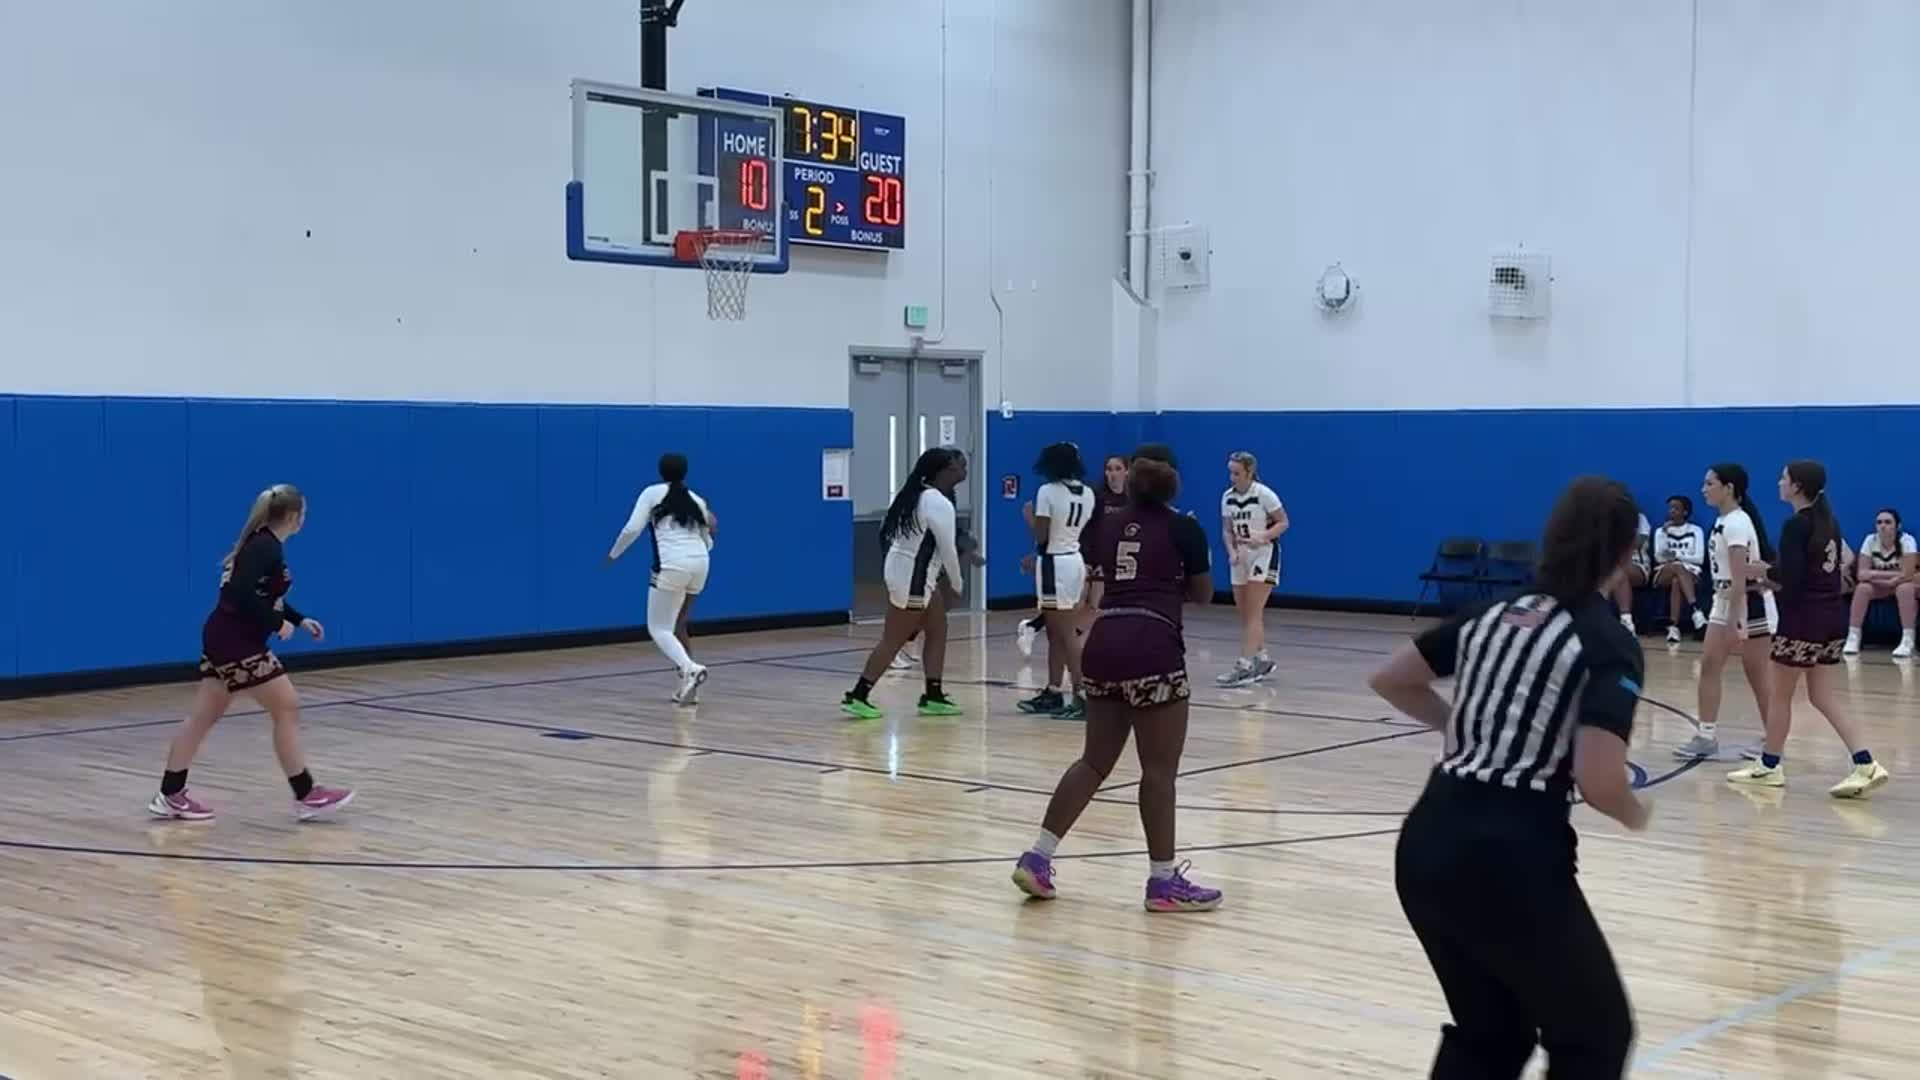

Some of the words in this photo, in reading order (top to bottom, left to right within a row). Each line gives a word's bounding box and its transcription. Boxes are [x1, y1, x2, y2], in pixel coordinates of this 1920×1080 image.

[723, 132, 767, 156] HOME
[792, 106, 856, 160] 7:34
[860, 151, 901, 174] GUEST
[742, 160, 768, 210] 10
[794, 167, 835, 184] PERIOD
[805, 186, 825, 235] 2
[866, 175, 901, 225] 20
[743, 218, 775, 233] BONU
[831, 215, 849, 225] POSS
[851, 229, 883, 243] BONUS
[1066, 501, 1083, 527] 11
[1236, 523, 1250, 539] 13
[1115, 540, 1141, 580] 5
